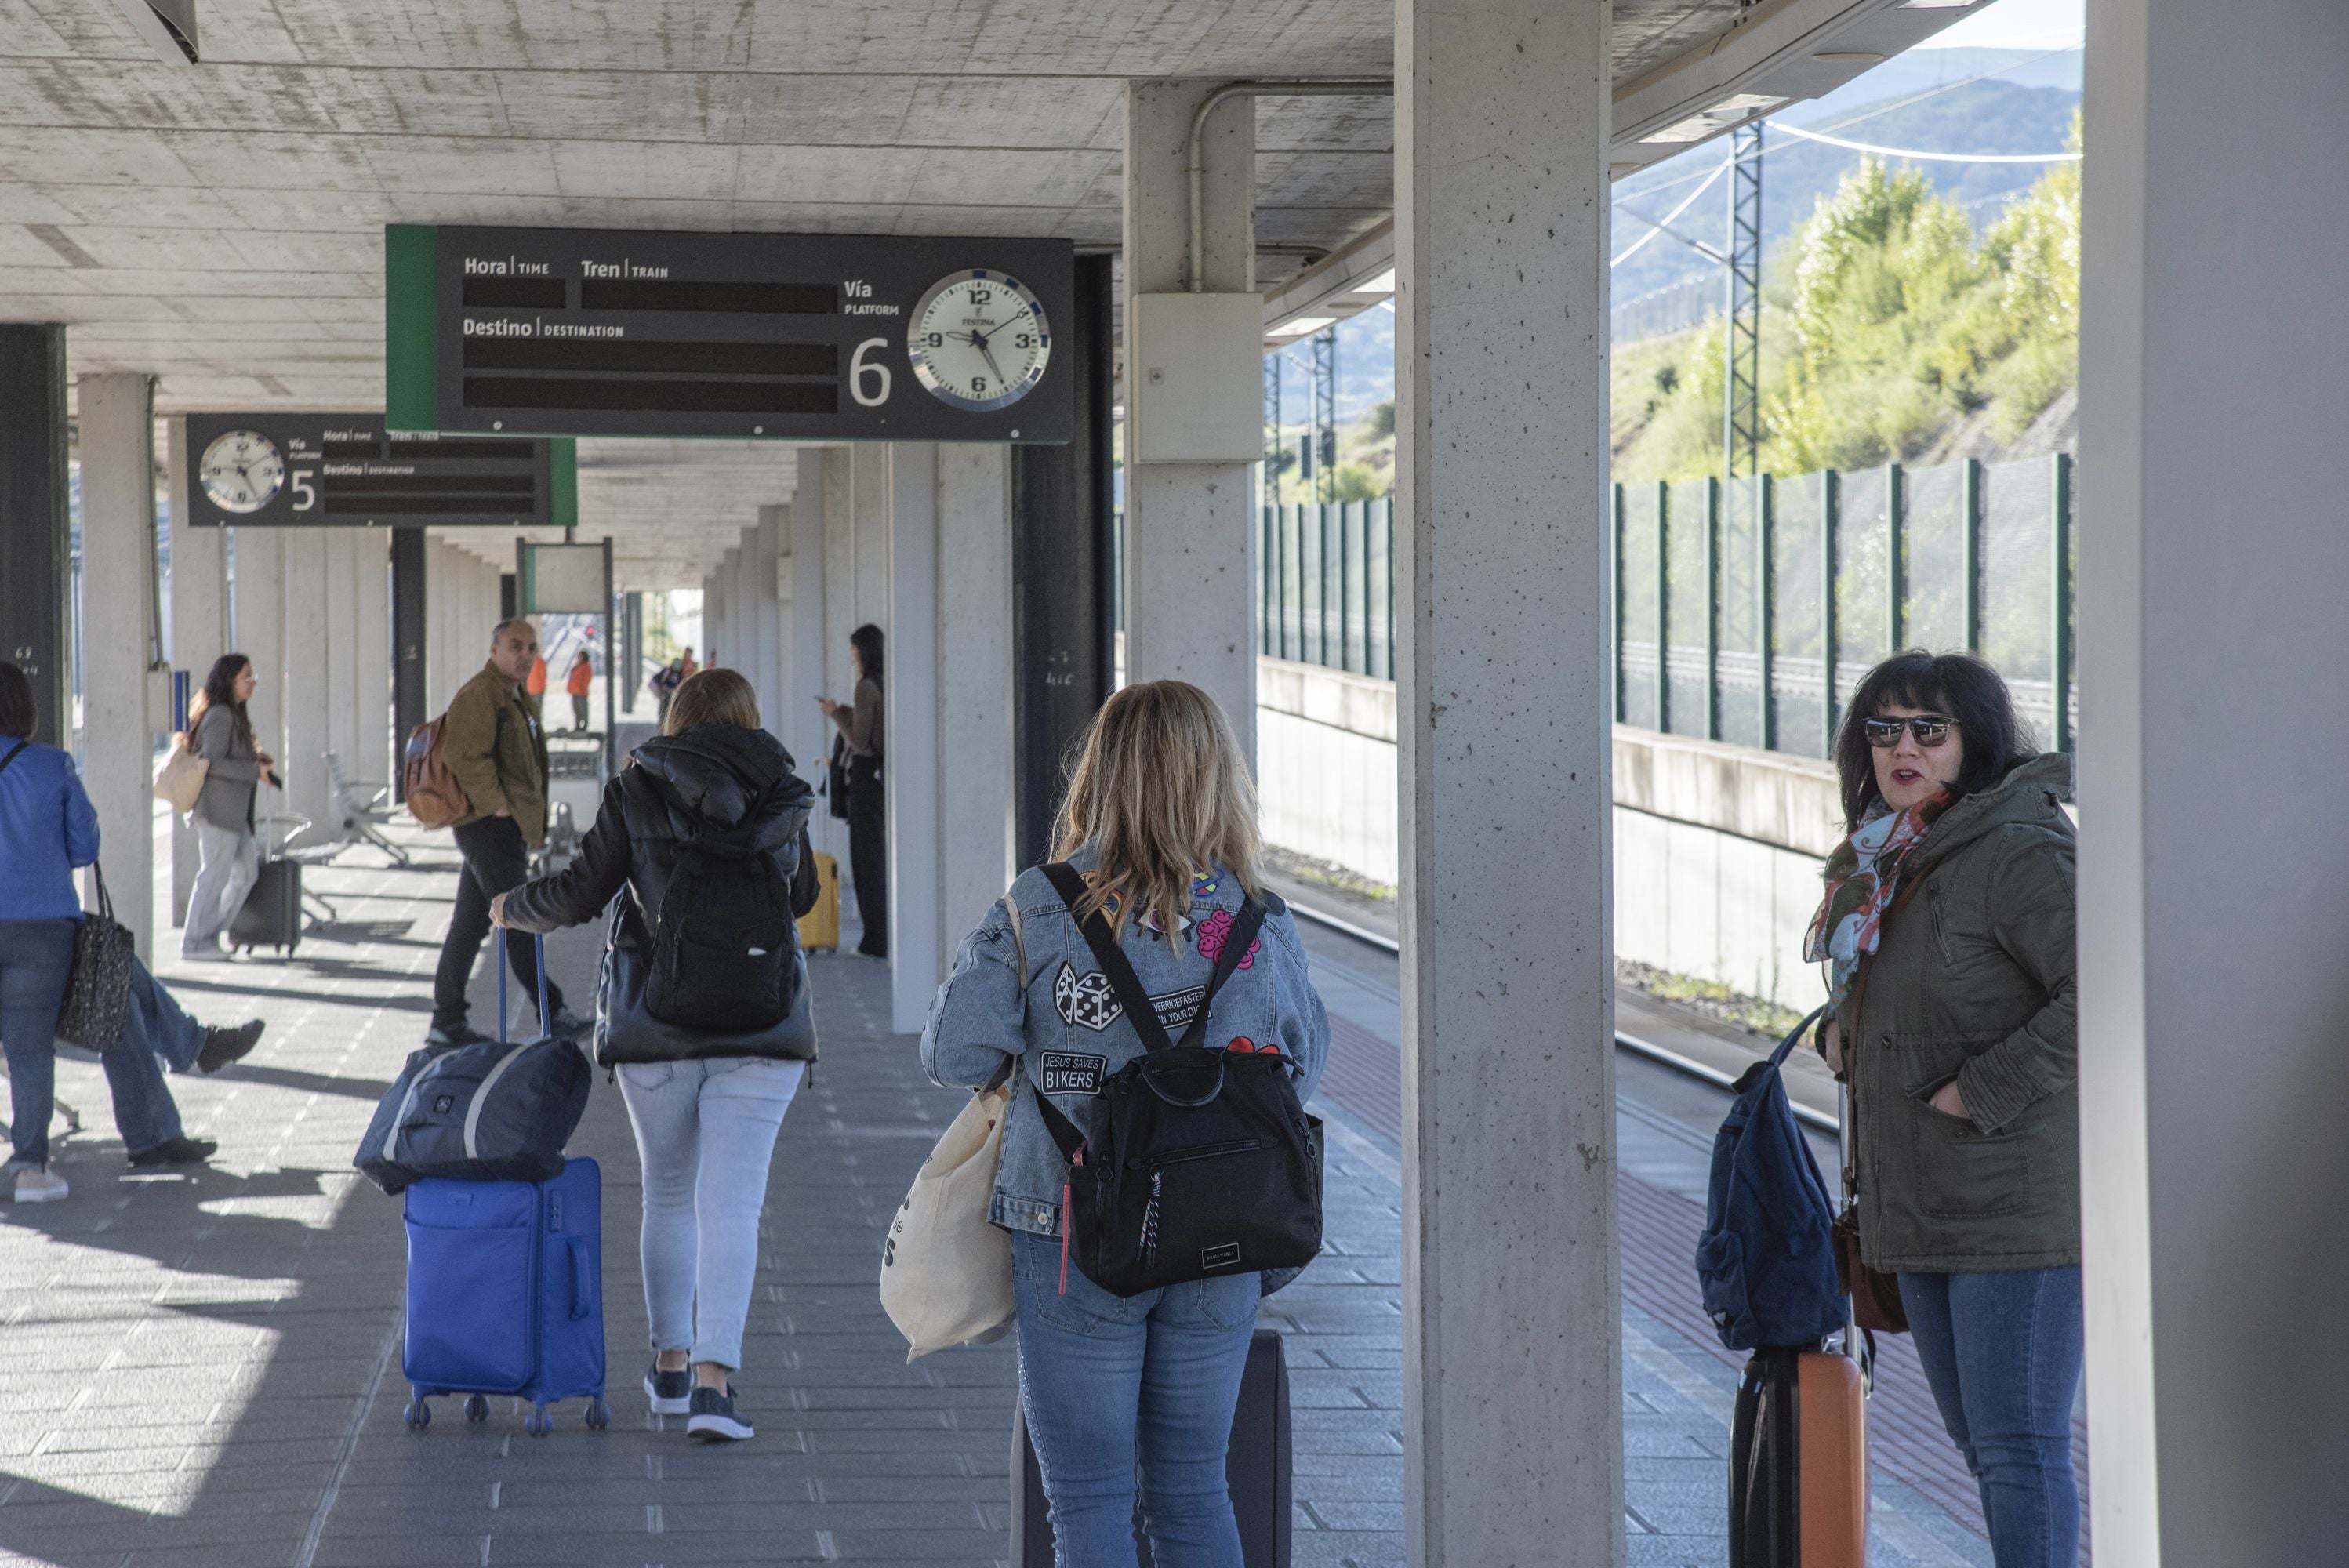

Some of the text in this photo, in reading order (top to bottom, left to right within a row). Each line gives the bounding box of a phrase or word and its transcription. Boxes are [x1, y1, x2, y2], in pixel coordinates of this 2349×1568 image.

[464, 257, 549, 275] Hora TIME
[580, 260, 669, 279] Tren TRAIN
[844, 281, 872, 298] Vía
[968, 290, 992, 305] 12
[844, 304, 899, 316] PLATFORM
[463, 319, 624, 338] Destino DESTINATION
[962, 318, 996, 327] FESTINA
[928, 332, 943, 348] 9
[1015, 333, 1030, 349] 3
[850, 338, 891, 407] 6
[971, 376, 986, 392] 6
[292, 470, 316, 512] 5
[1167, 1010, 1188, 1022] YOUR
[1045, 1055, 1099, 1070] JESUS SAVES
[1047, 1071, 1094, 1089] BIKERS
